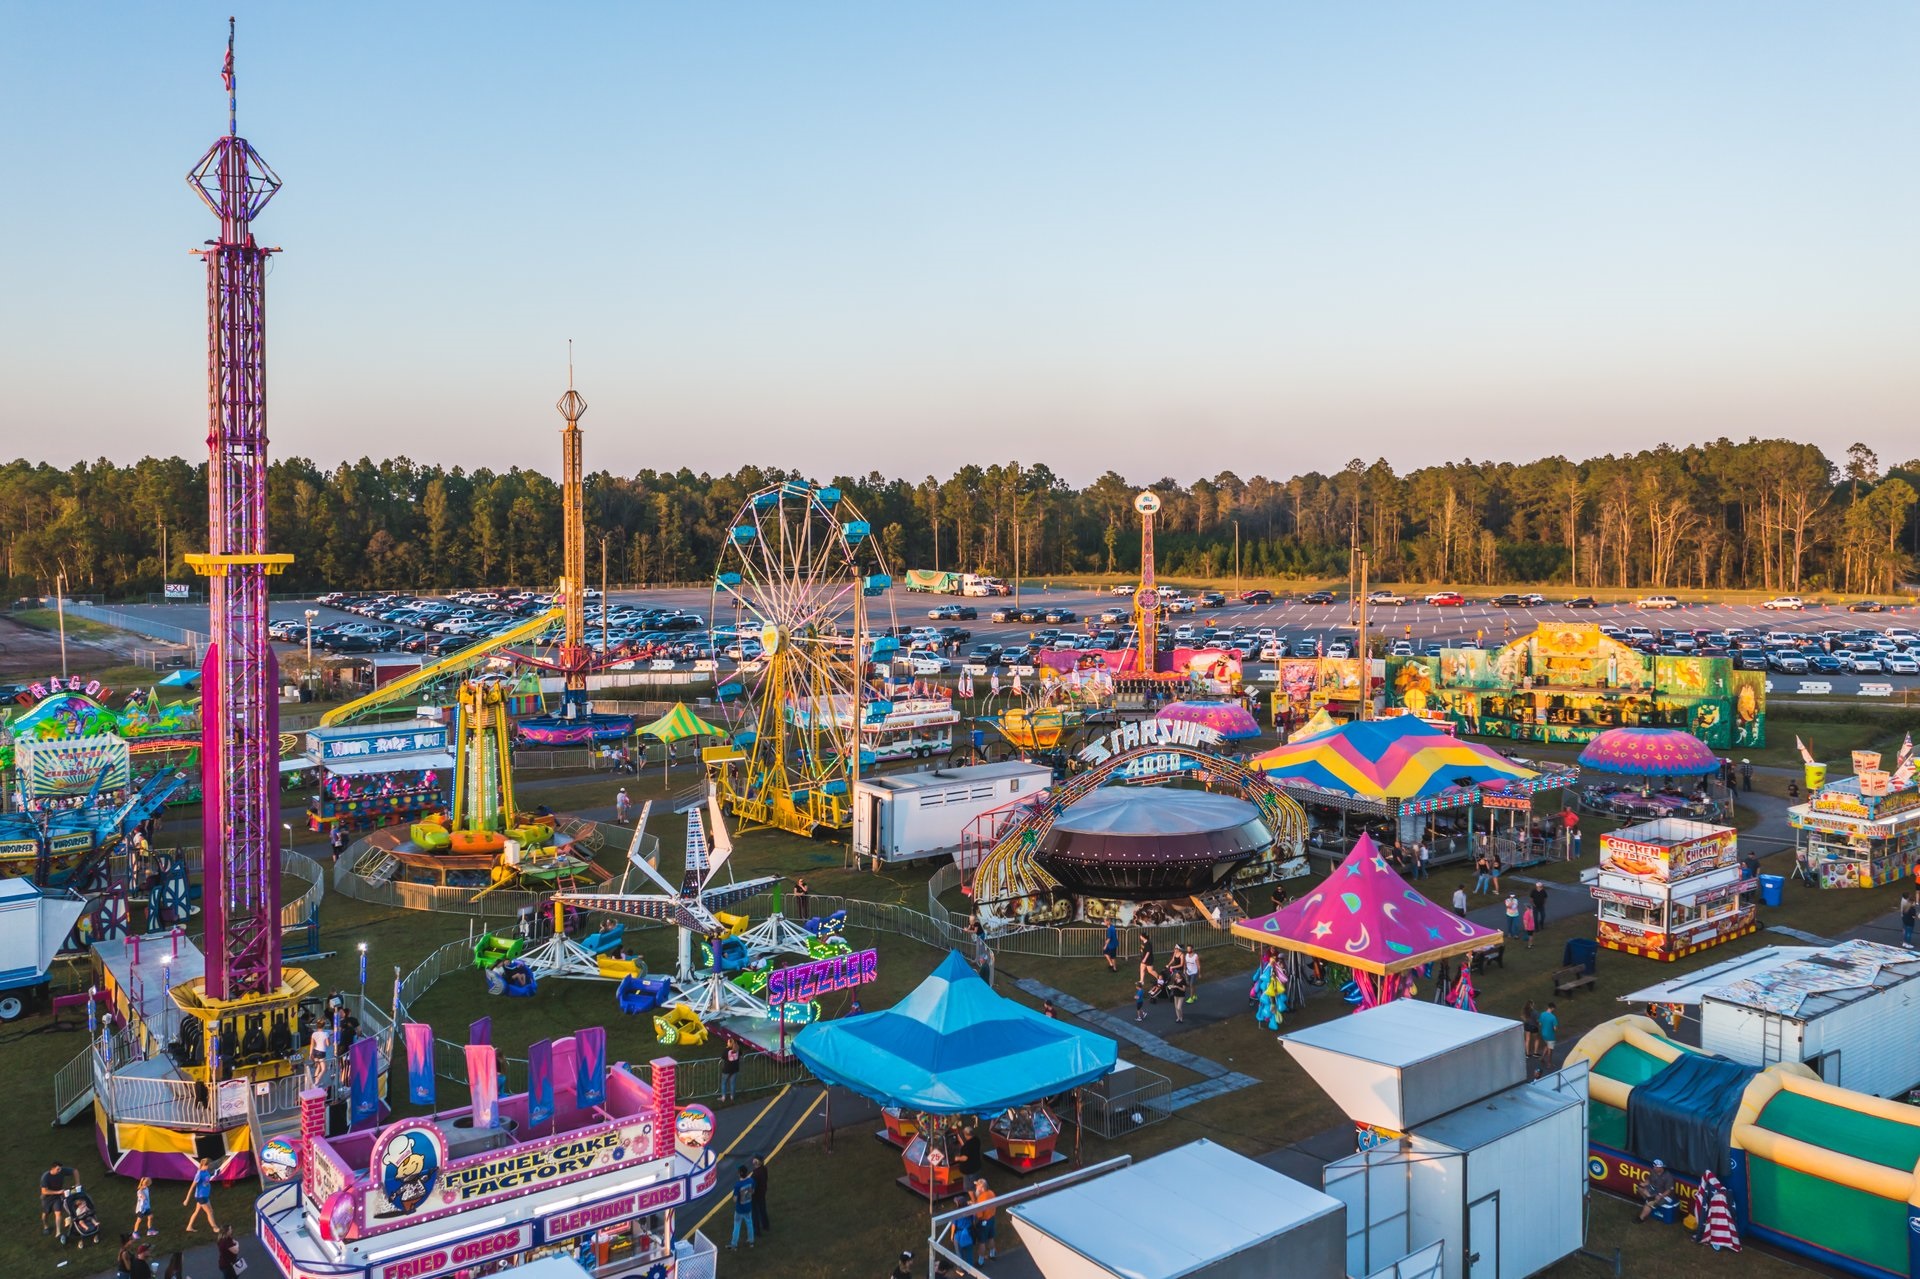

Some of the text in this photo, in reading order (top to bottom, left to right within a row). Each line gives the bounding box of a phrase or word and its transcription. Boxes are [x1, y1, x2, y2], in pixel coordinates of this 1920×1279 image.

[15, 675, 114, 708] DRAGON
[1077, 718, 1224, 765] STARSHIP
[1126, 754, 1181, 776] 4000
[1815, 800, 1837, 811] SWEET
[53, 836, 89, 849] WINDSURFER
[1608, 838, 1661, 858] CHICKEN
[1686, 843, 1718, 863] CHICKEN
[768, 949, 878, 1006] SIZZLER
[445, 1133, 620, 1188] FUNNEL CAKE
[461, 1155, 597, 1199] FACTORY
[1619, 1163, 1699, 1198] SHOING
[550, 1198, 635, 1237] ELEPHANT
[638, 1183, 682, 1208] EARS
[383, 1228, 521, 1279] FRIED OREOS
